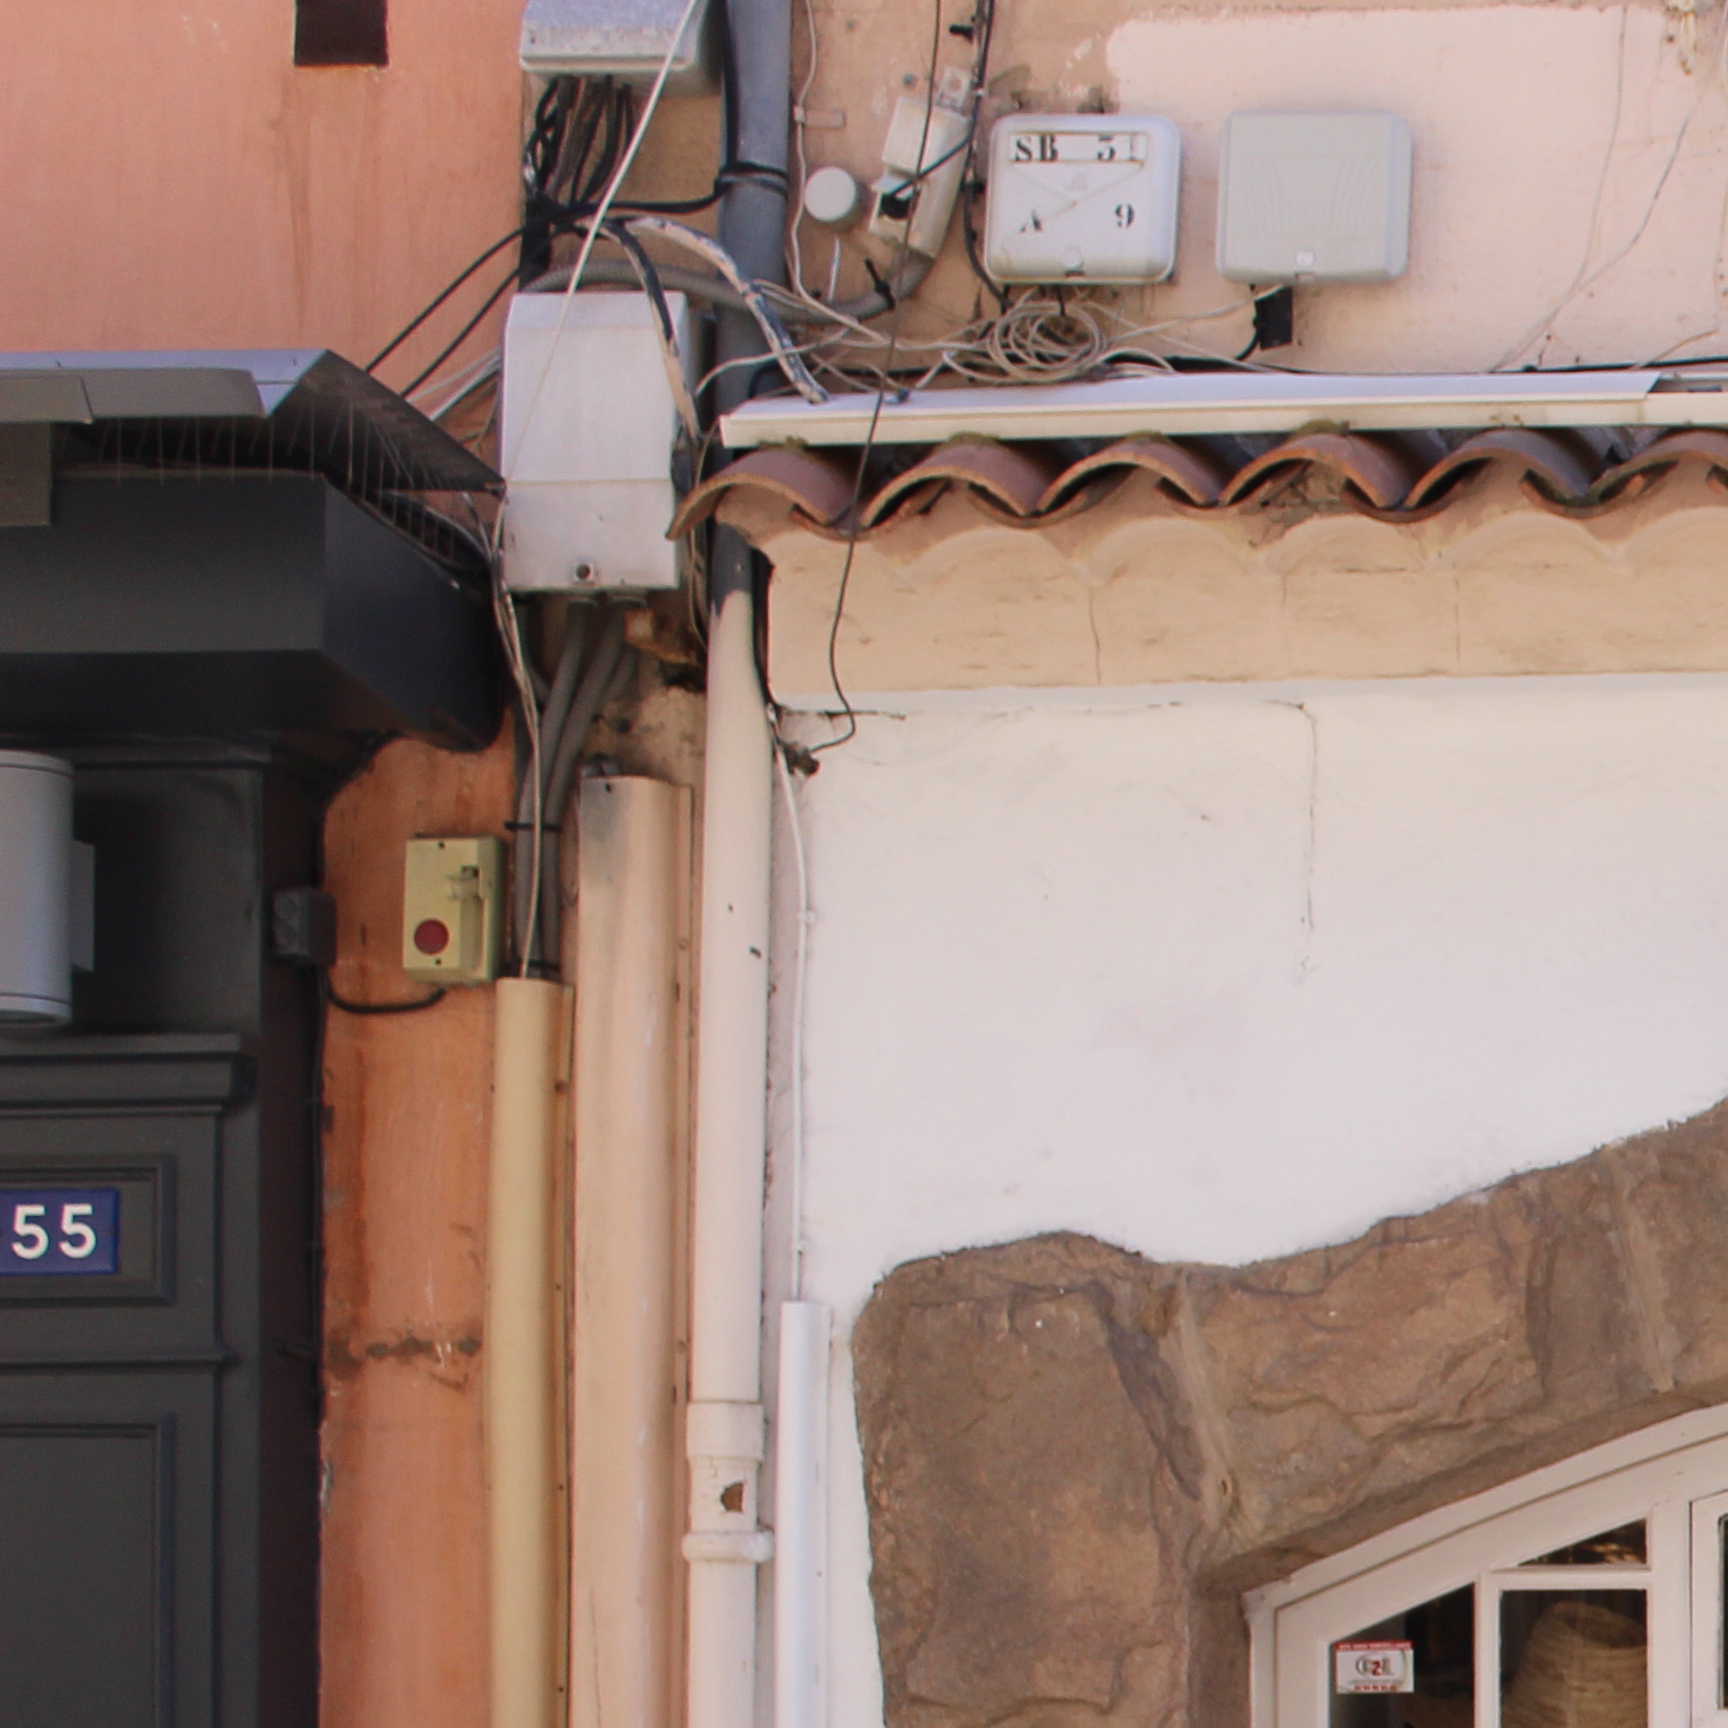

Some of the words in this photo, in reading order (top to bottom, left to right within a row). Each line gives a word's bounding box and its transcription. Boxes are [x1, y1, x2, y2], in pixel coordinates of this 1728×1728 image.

[1015, 134, 1059, 162] SB
[1115, 202, 1136, 229] 9
[11, 1203, 97, 1260] 55
